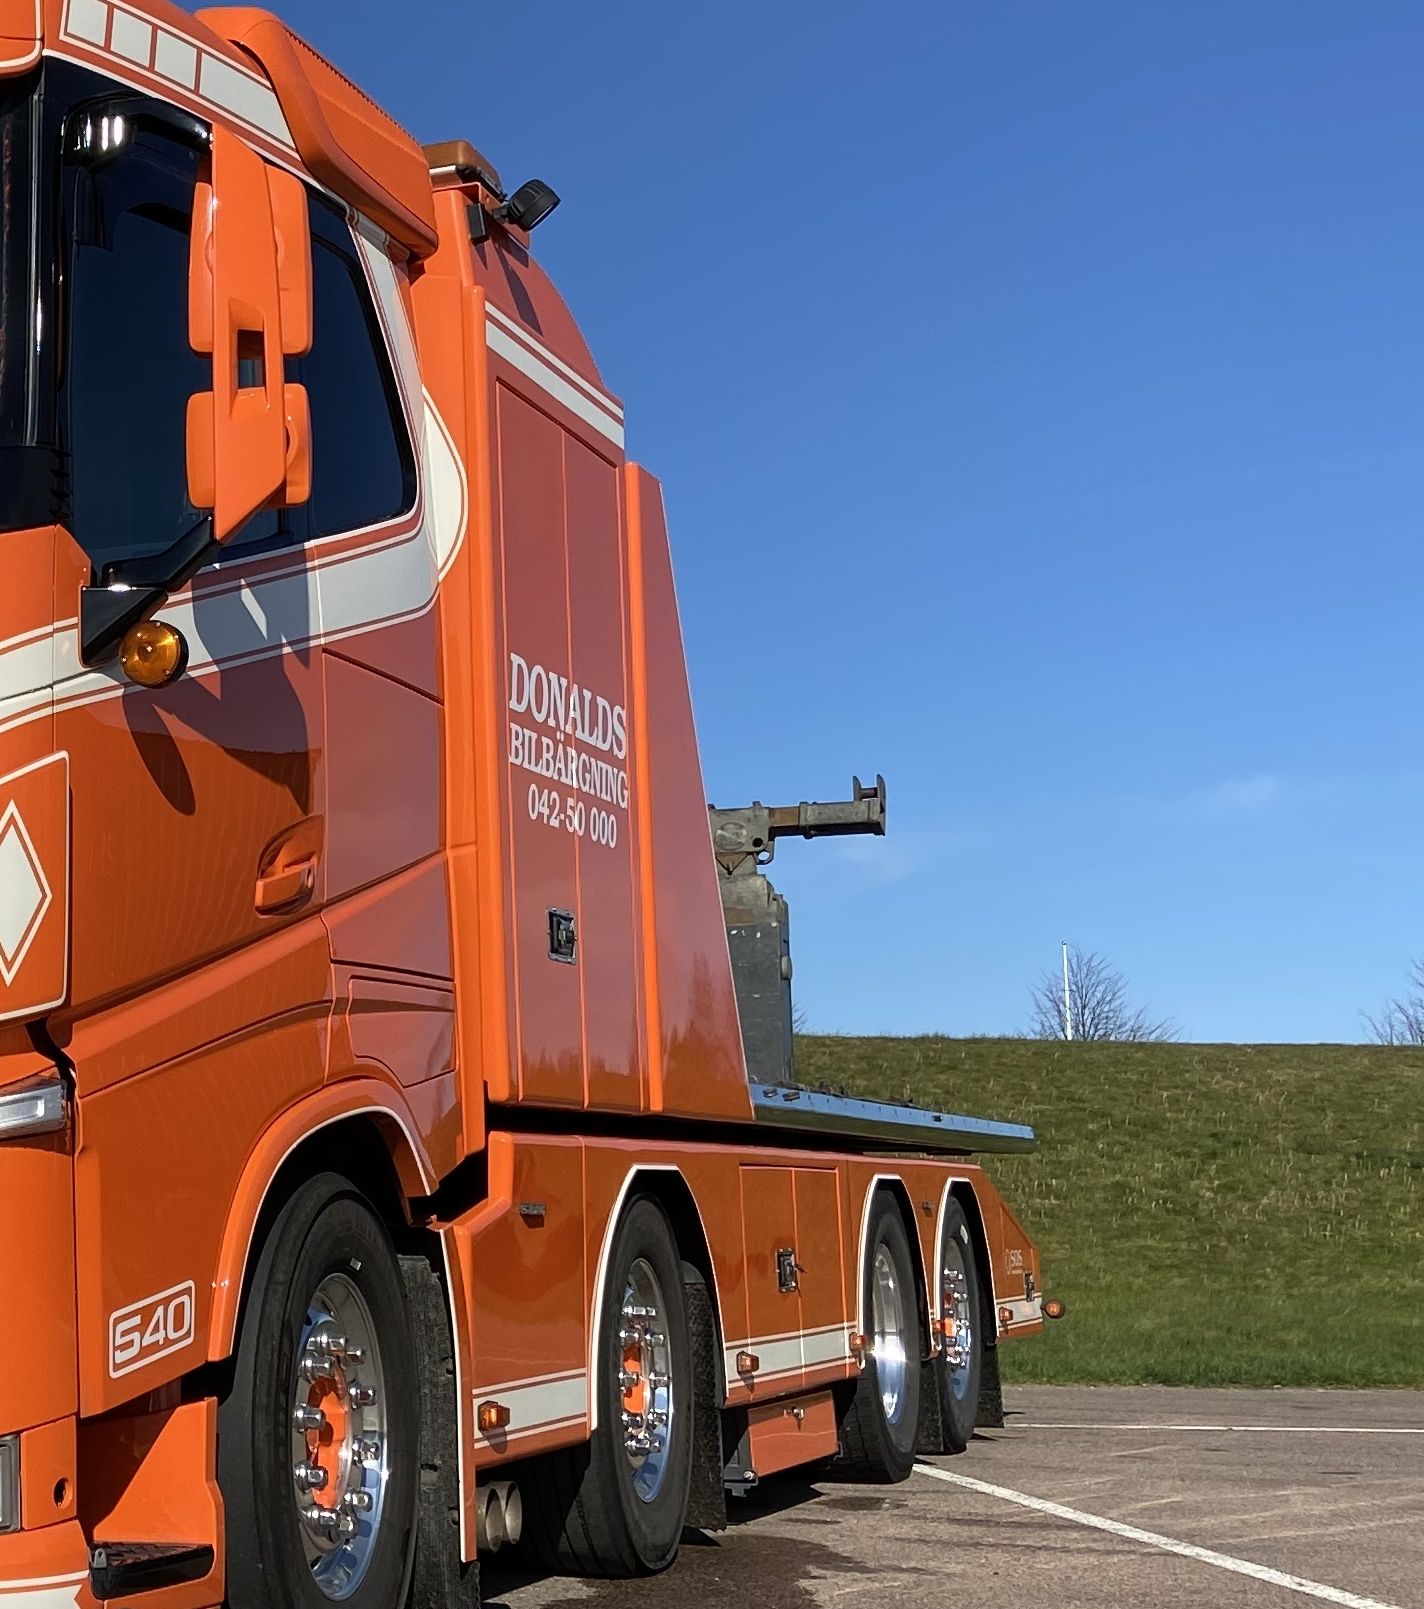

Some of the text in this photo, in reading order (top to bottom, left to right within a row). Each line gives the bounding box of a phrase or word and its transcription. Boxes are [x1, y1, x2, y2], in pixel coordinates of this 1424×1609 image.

[509, 652, 627, 760] DONALDS
[509, 722, 629, 810] BILBÄRGNING
[528, 783, 617, 849] 042-50 000
[114, 1294, 191, 1364] 540
